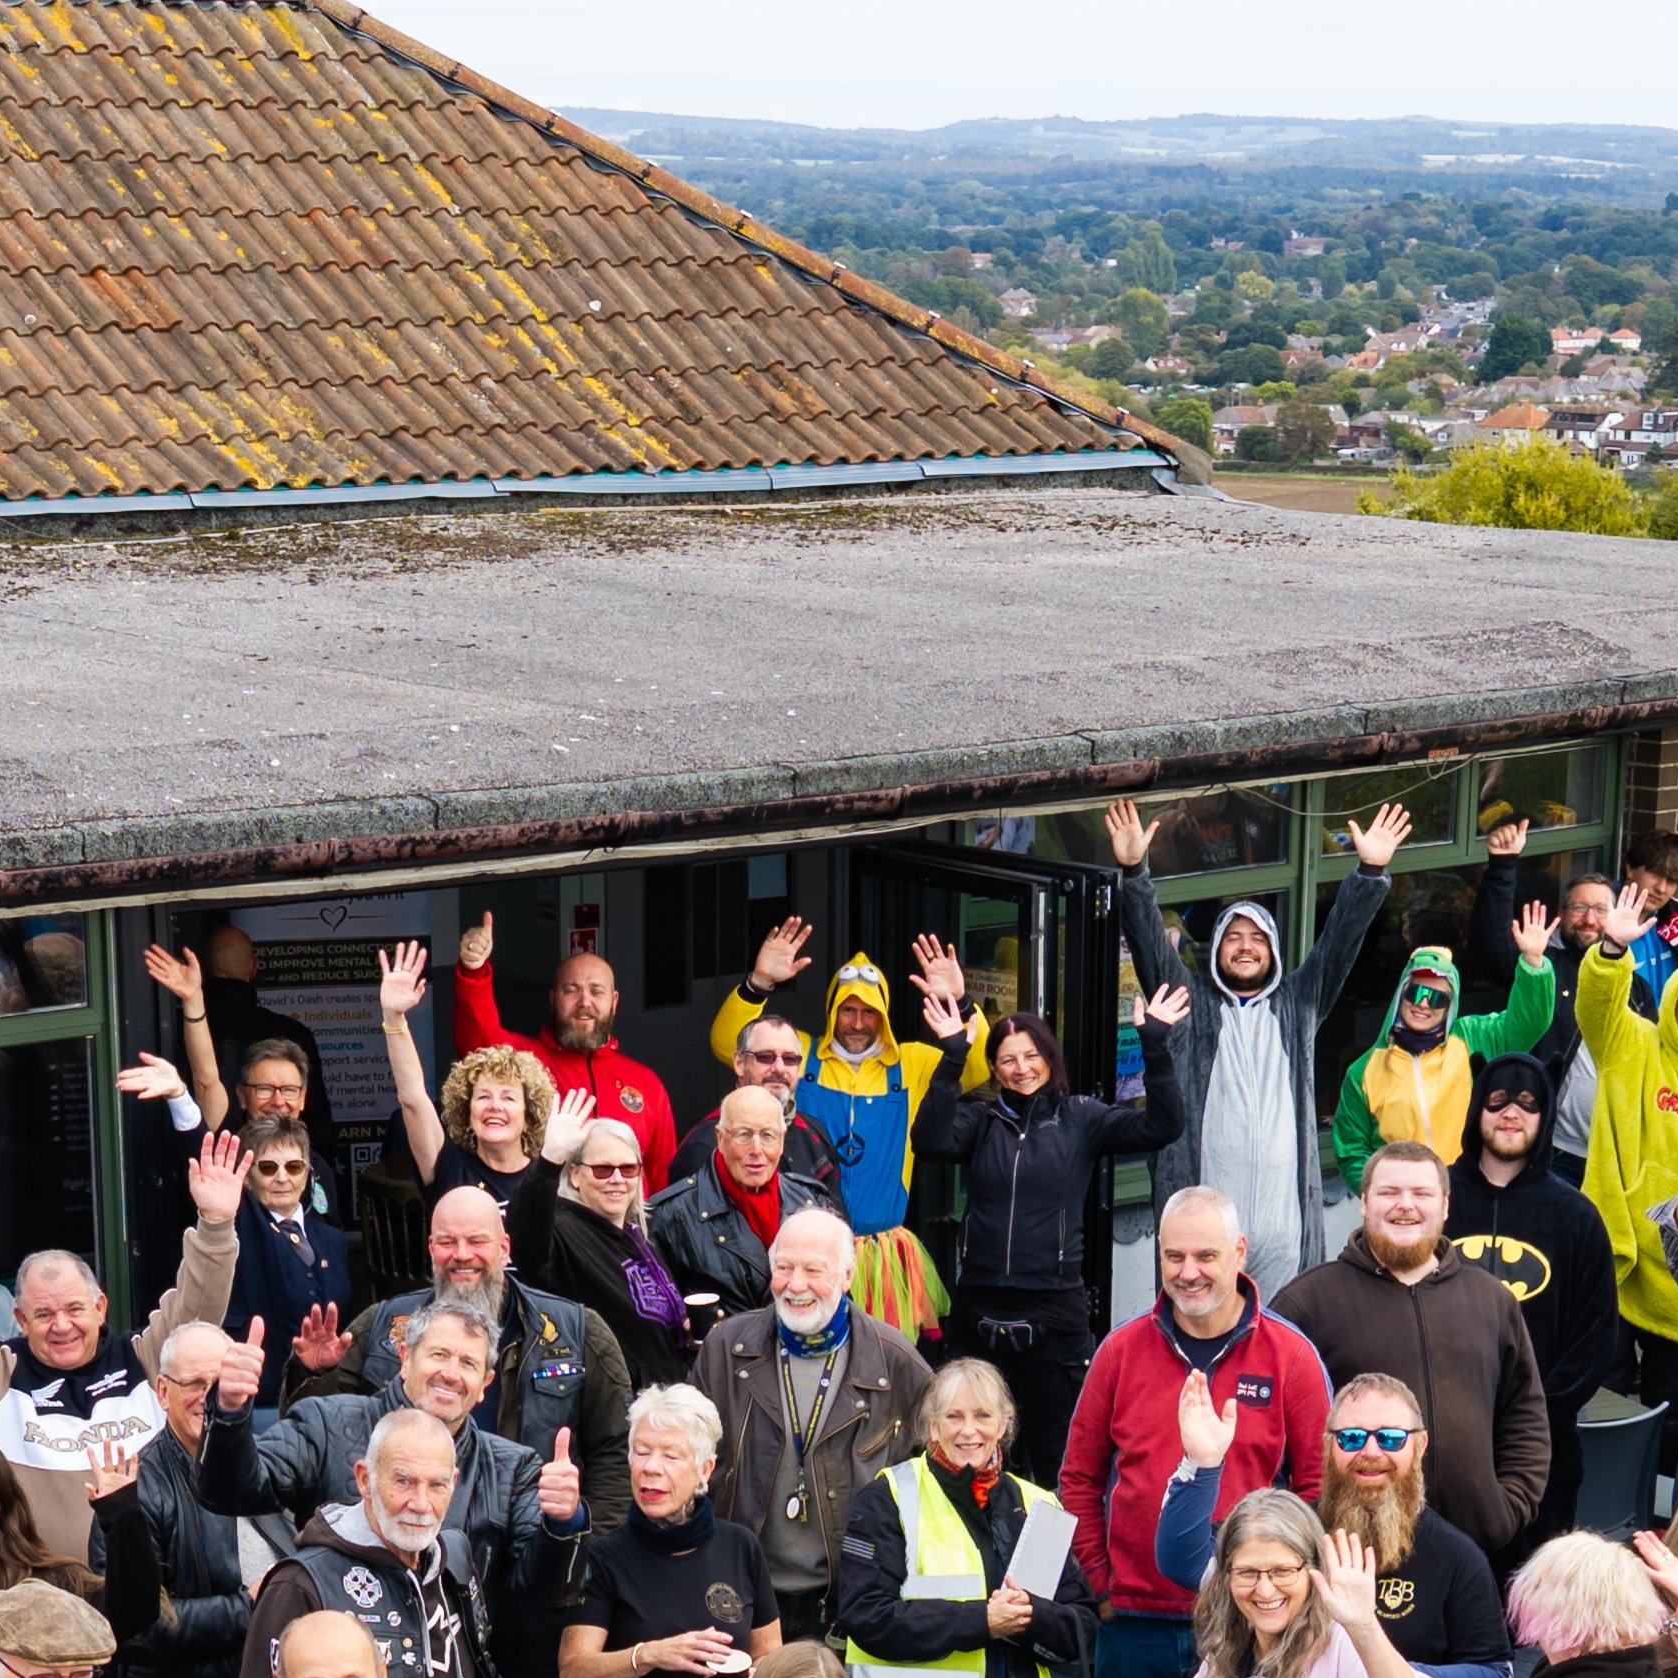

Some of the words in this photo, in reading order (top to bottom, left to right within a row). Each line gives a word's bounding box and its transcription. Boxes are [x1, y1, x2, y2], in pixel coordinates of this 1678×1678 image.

[254, 944, 324, 958] DEVELOPING
[326, 942, 395, 956] CONNECTIO
[269, 958, 326, 970] IMPROVE
[328, 956, 373, 968] MENTAL
[278, 973, 300, 982] AND
[302, 970, 351, 981] REDUCE
[353, 969, 382, 980] SUIC
[297, 994, 323, 1005] Dash
[325, 994, 361, 1005] creates
[361, 994, 381, 1007] spa
[304, 1009, 373, 1021] Individuals
[318, 1041, 365, 1051] esources
[321, 1053, 351, 1065] pport
[353, 1053, 389, 1064] service
[324, 1071, 342, 1083] uld
[344, 1072, 371, 1081] have
[373, 1072, 385, 1081] to
[336, 1083, 375, 1095] mental
[377, 1082, 397, 1093] hea
[346, 1096, 379, 1108] alone.
[338, 1126, 372, 1139] ARN
[23, 1416, 153, 1453] HONDA
[1378, 1577, 1415, 1602] TBB
